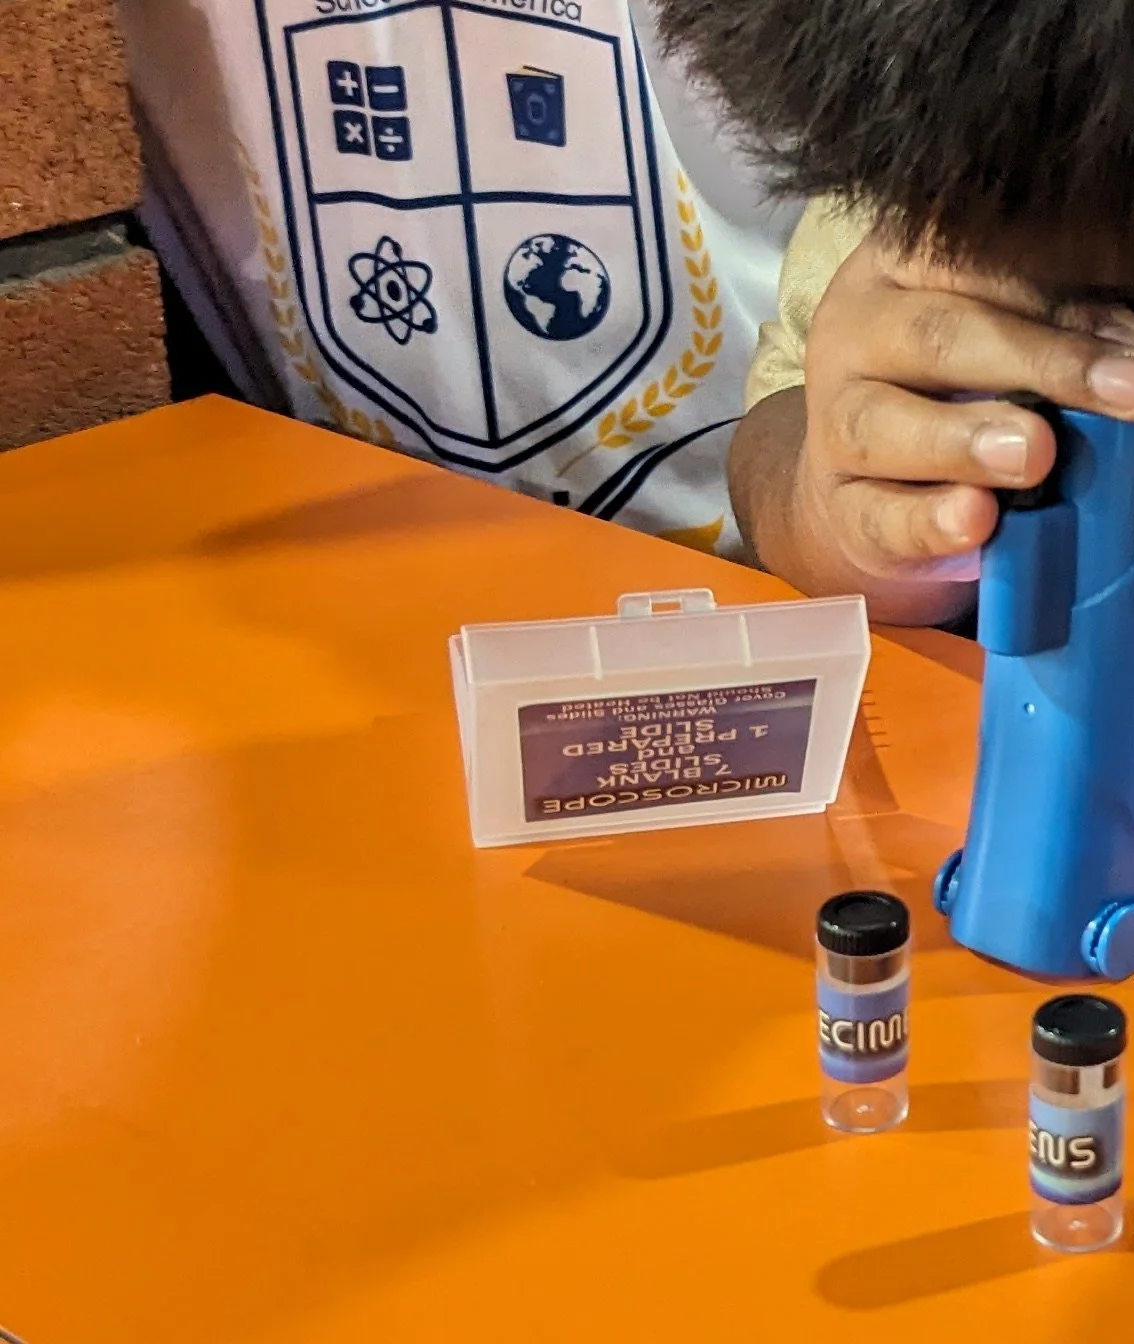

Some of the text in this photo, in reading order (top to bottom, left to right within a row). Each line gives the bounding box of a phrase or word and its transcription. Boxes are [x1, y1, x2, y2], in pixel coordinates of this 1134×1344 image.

[734, 690, 786, 703] Cover
[546, 708, 605, 721] Slides
[612, 704, 647, 716] and
[620, 719, 715, 739] SLIDE
[562, 724, 769, 757] 1 PREPARED
[638, 744, 696, 761] and
[609, 753, 723, 775] SLIDES
[597, 763, 733, 789] 7 BLANK
[543, 774, 786, 814] MICROSCOPE
[818, 1006, 908, 1052] ECIM
